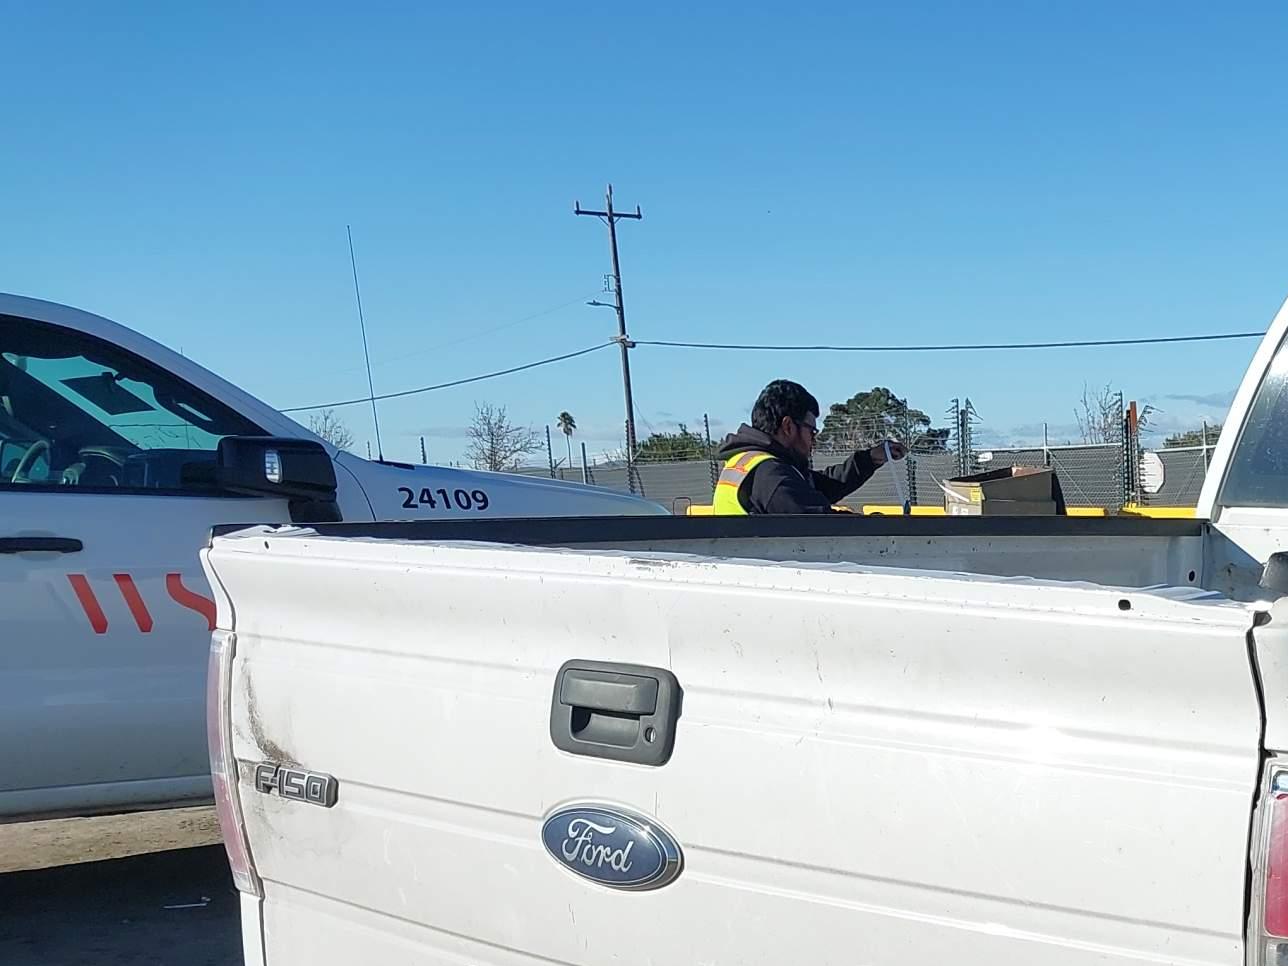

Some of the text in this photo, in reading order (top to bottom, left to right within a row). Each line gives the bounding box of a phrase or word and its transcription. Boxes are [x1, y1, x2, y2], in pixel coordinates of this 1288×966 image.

[397, 487, 489, 511] 24109
[256, 764, 328, 807] F-150
[562, 818, 634, 873] Ford
